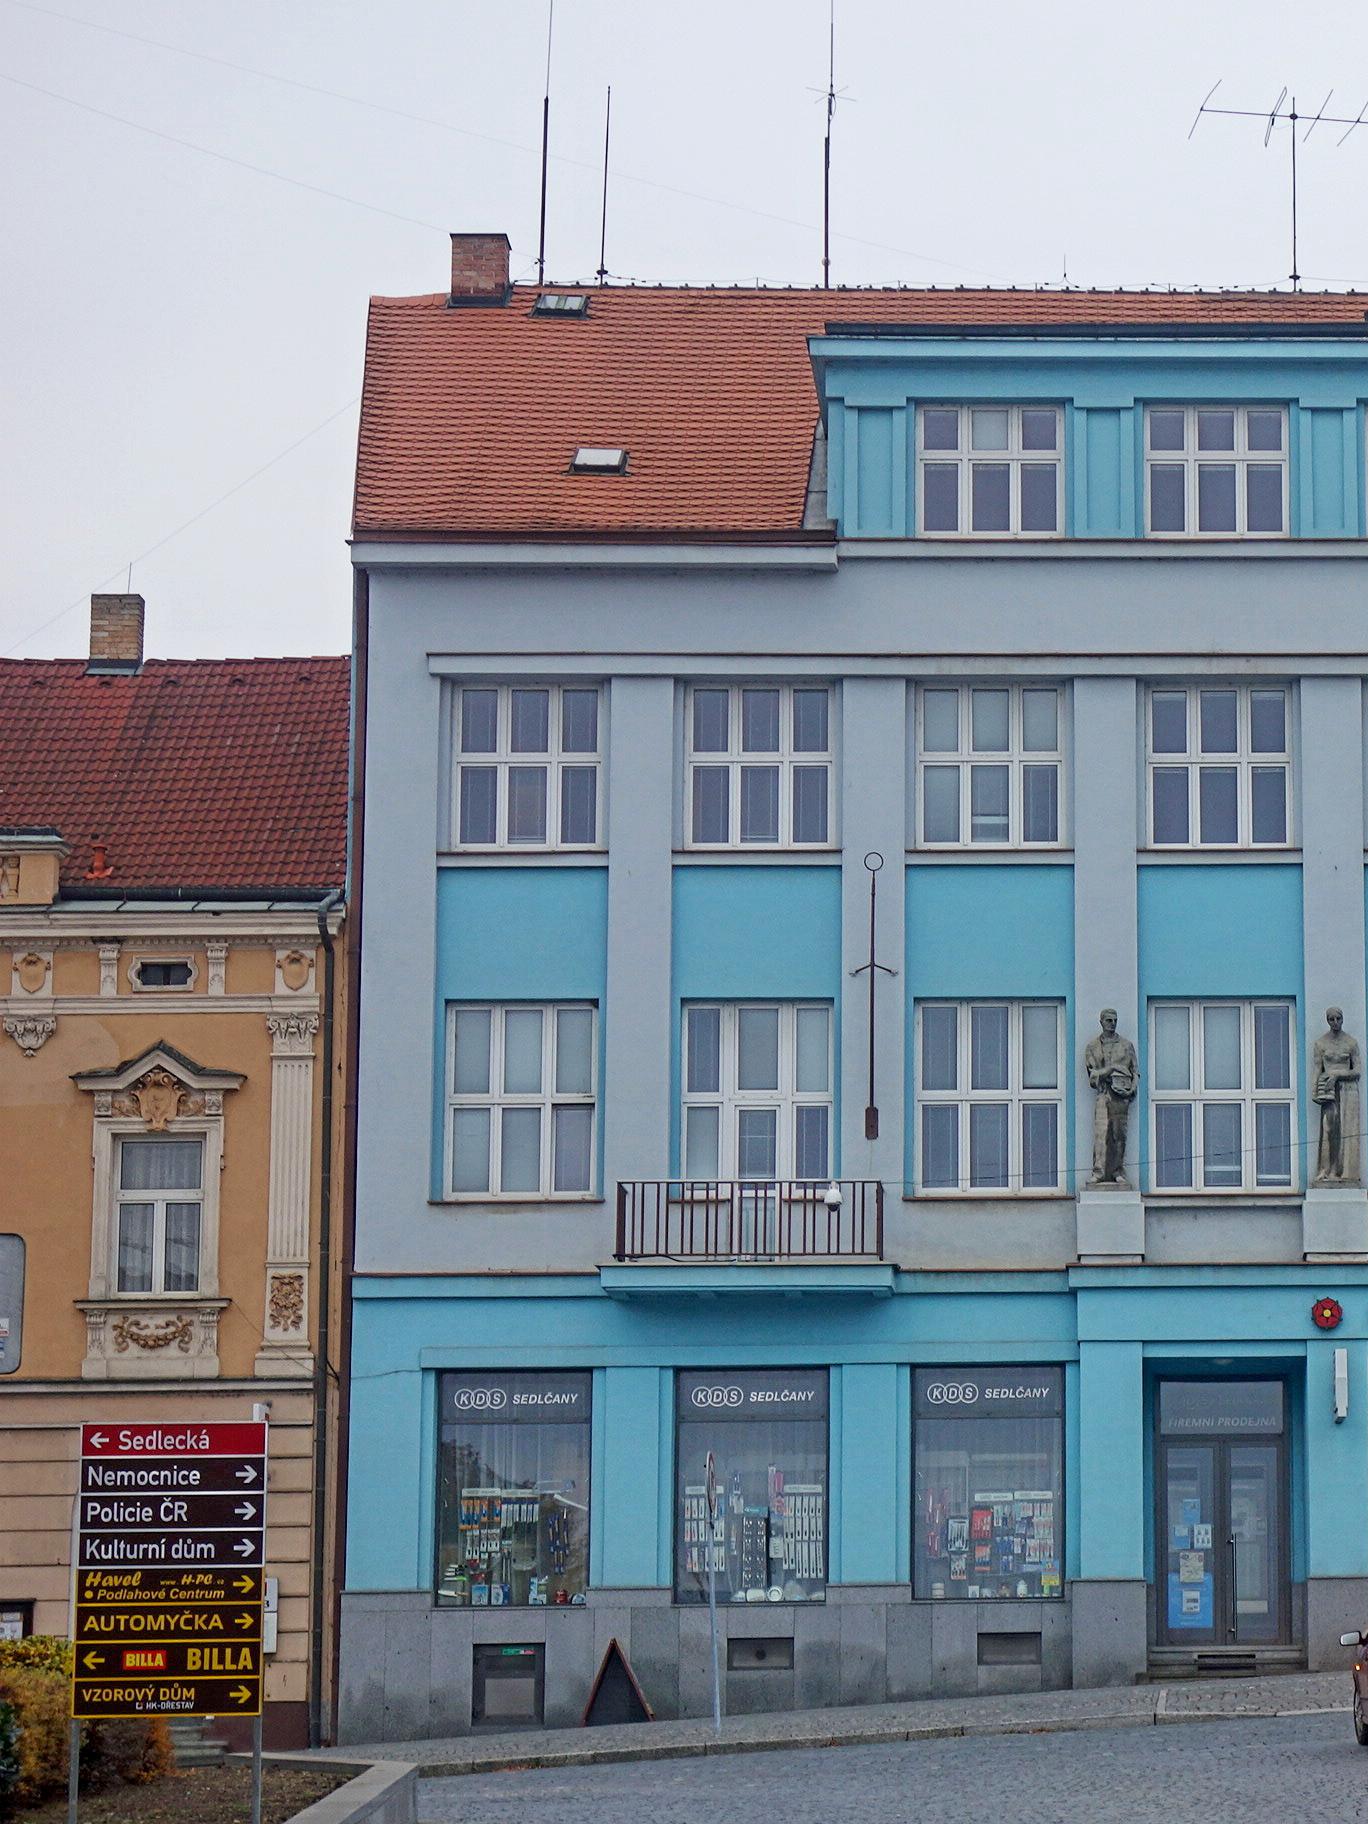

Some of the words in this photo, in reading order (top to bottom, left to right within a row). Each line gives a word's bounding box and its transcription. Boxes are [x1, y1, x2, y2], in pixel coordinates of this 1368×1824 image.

[457, 1391, 504, 1406] KDS
[512, 1392, 578, 1404] SEDLČANY
[694, 1388, 741, 1404] KDS
[749, 1389, 815, 1402] SEDLČANY
[929, 1385, 976, 1401] KDS
[984, 1386, 1050, 1399] SEDLČANY
[1217, 1416, 1276, 1428] PRODEJNA
[118, 1429, 210, 1451] Sedlecká
[87, 1465, 201, 1487] Nemocnice
[86, 1501, 153, 1522] Policie
[159, 1497, 188, 1522] ČR
[85, 1538, 166, 1560] Kulturní
[171, 1538, 216, 1559] dům
[85, 1571, 142, 1588] Havel
[97, 1588, 165, 1600] Podlahové
[169, 1588, 225, 1600] Centrum
[83, 1610, 224, 1632] AUTOMYČKA
[125, 1652, 164, 1667] BILLA
[187, 1648, 253, 1671] BILLA
[82, 1684, 155, 1702] VZOROVÝ
[160, 1682, 195, 1701] DŮM
